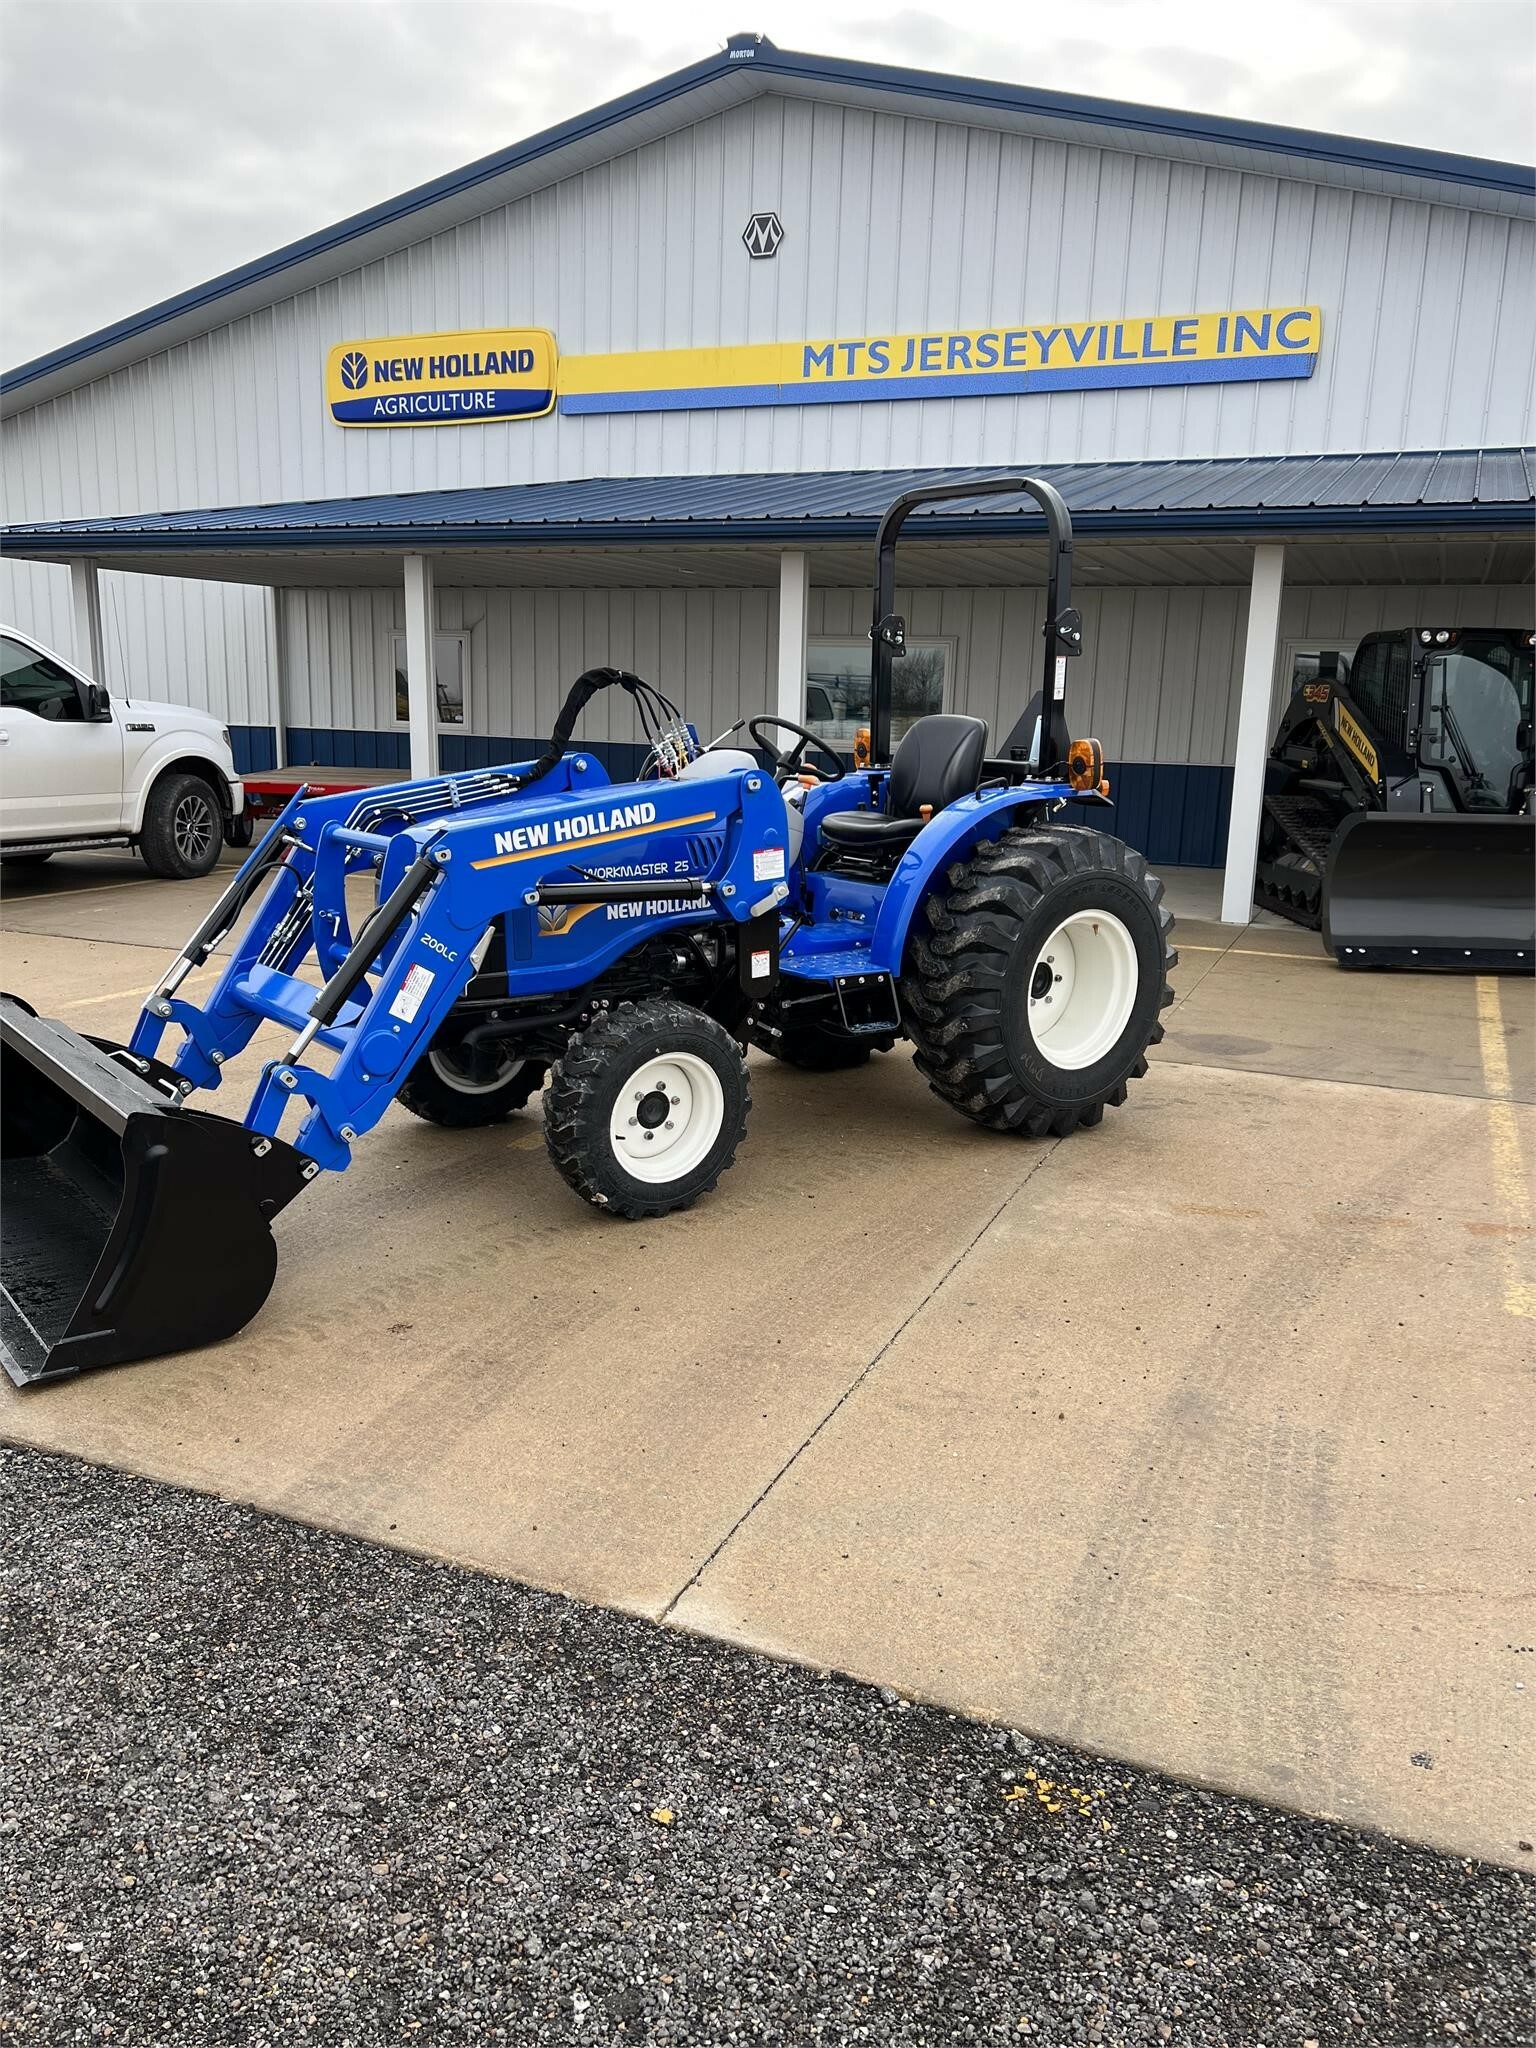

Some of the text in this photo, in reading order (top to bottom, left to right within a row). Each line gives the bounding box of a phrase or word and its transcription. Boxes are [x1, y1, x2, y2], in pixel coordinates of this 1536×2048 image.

[802, 311, 1312, 378] MTS JERSEYVILLE INC
[374, 349, 535, 383] NEW HOLLAND
[373, 391, 496, 416] AGRICULTURE
[1341, 715, 1375, 767] NEW HOLLAND
[494, 802, 656, 855] NEW HOLLAND
[674, 860, 689, 873] 25
[607, 902, 643, 920] NEW
[420, 932, 458, 962] 200LC
